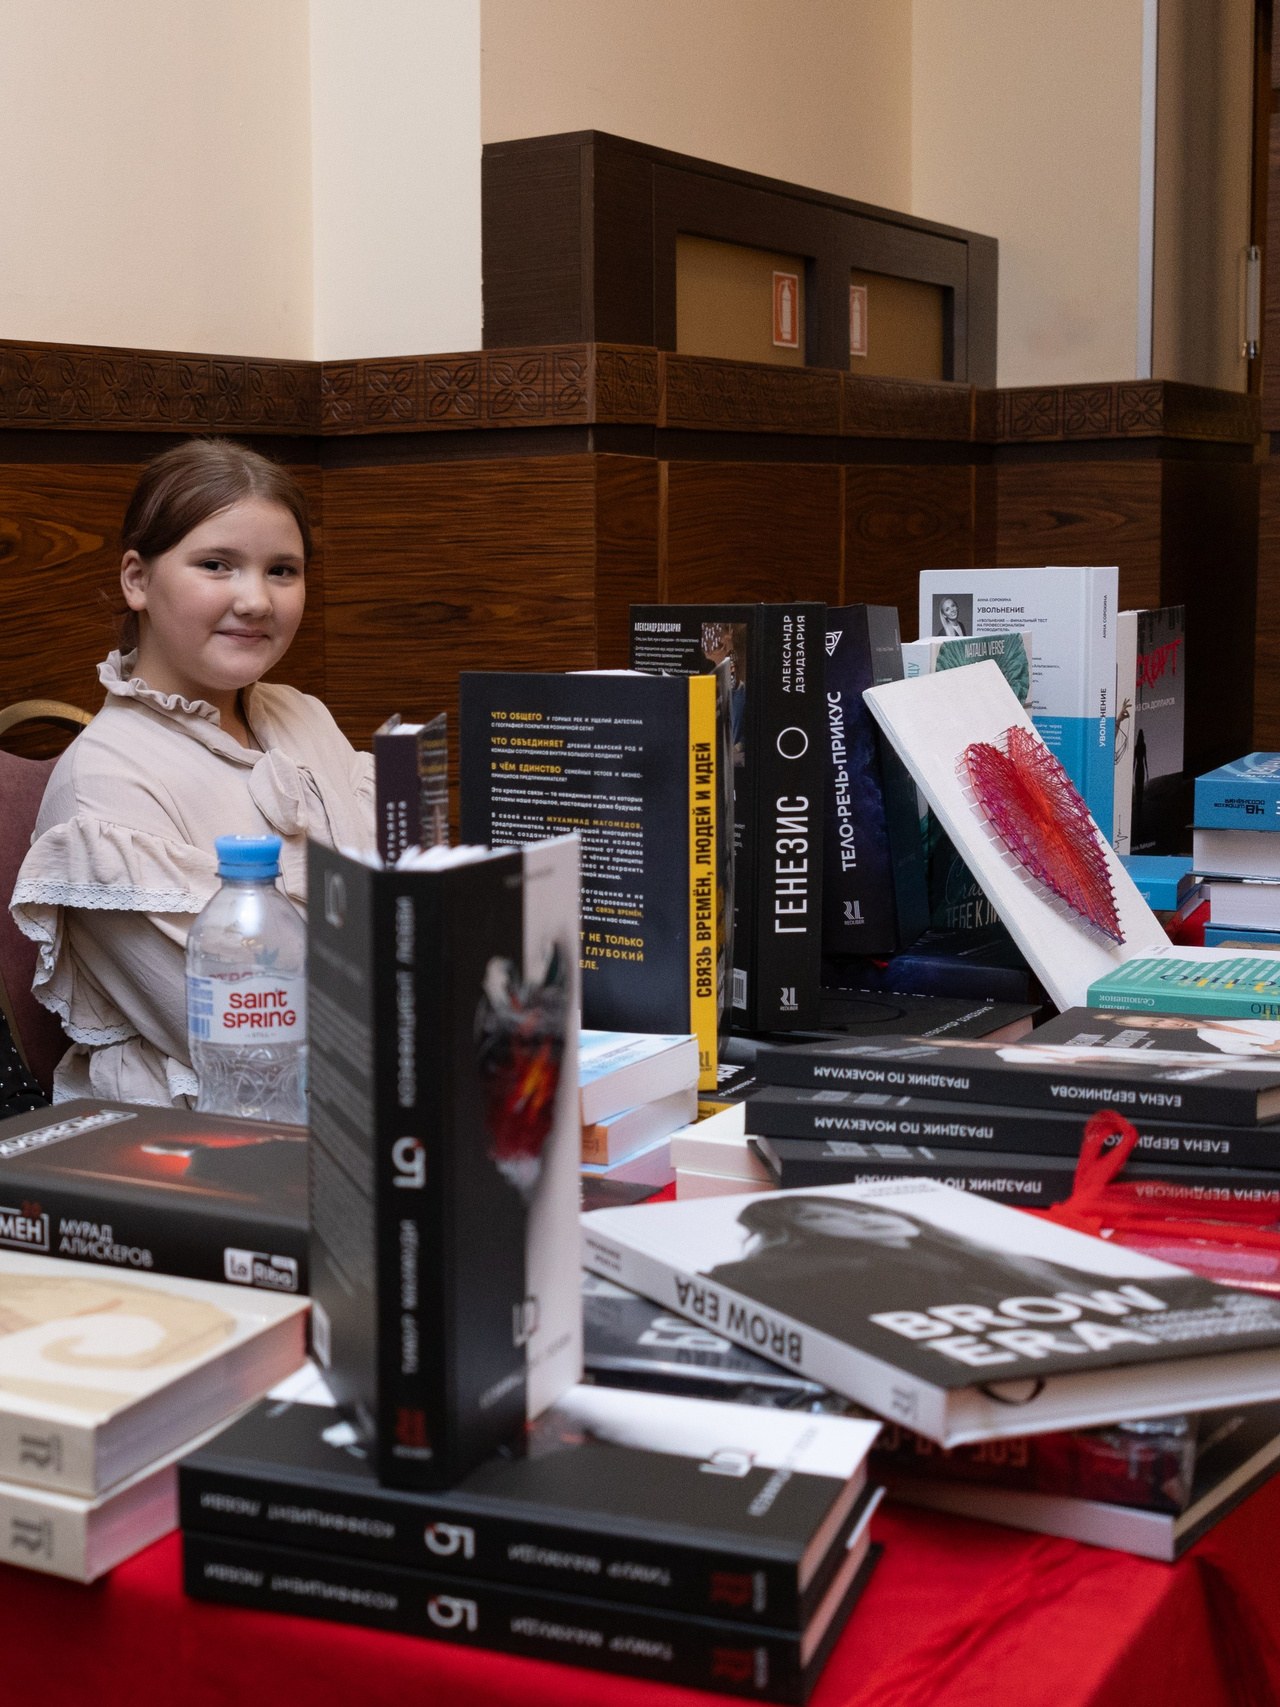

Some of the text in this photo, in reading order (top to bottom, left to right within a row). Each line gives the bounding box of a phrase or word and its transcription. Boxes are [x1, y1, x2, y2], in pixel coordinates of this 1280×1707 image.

[782, 615, 792, 693] АЛЕКСАНДР
[796, 615, 806, 693] ДЗИДЗАРИЯ
[964, 640, 1005, 658] NATALIA VERSE
[491, 712, 507, 720] ЧТО
[509, 712, 542, 721] ОБЩЕГО
[1099, 688, 1107, 747] УВОЛЬНЕНИЕ
[491, 737, 507, 745] ЧТО
[511, 738, 564, 748] ОБЪЕДИНЯЕТ
[491, 762, 496, 770] В
[500, 761, 516, 771] ЧЁМ
[519, 764, 561, 773] ЕДИНСТВО
[692, 742, 713, 784] ИДЕЙ
[547, 816, 589, 826] МУХАММАД
[1246, 805, 1264, 815] 48
[692, 808, 713, 866] ЛЮДЕЙ
[775, 795, 809, 933] ГЕНЕЗИС
[692, 871, 713, 941] ВРЕМЁН,
[589, 933, 601, 942] НЕ
[605, 935, 643, 947] ТОЛЬКО
[586, 946, 643, 962] ГЛУБОКИЙ
[695, 946, 712, 998] СВЯЗЬ
[229, 990, 288, 1009] saint
[1099, 995, 1155, 1007] Селюшенок
[814, 1066, 970, 1090] ПРАЗДНИК ПО МОЛЕКУЛАМ
[1049, 1083, 1182, 1107] ЕЛЕНА БЕРДНИКОВА
[814, 1116, 994, 1139] ПРАЗДНИК ПО МОЛЕКУЛАМ
[1183, 1139, 1230, 1153] ЕЛЕНА
[969, 1175, 1042, 1195] ПРАЗДНИК
[59, 1218, 113, 1244] МУРАД
[59, 1237, 153, 1267] АЛИСКЕРОВ
[672, 1274, 721, 1325] ERA
[869, 1285, 1168, 1341] BROW
[726, 1301, 804, 1366] BROW
[925, 1320, 1161, 1367] ERA
